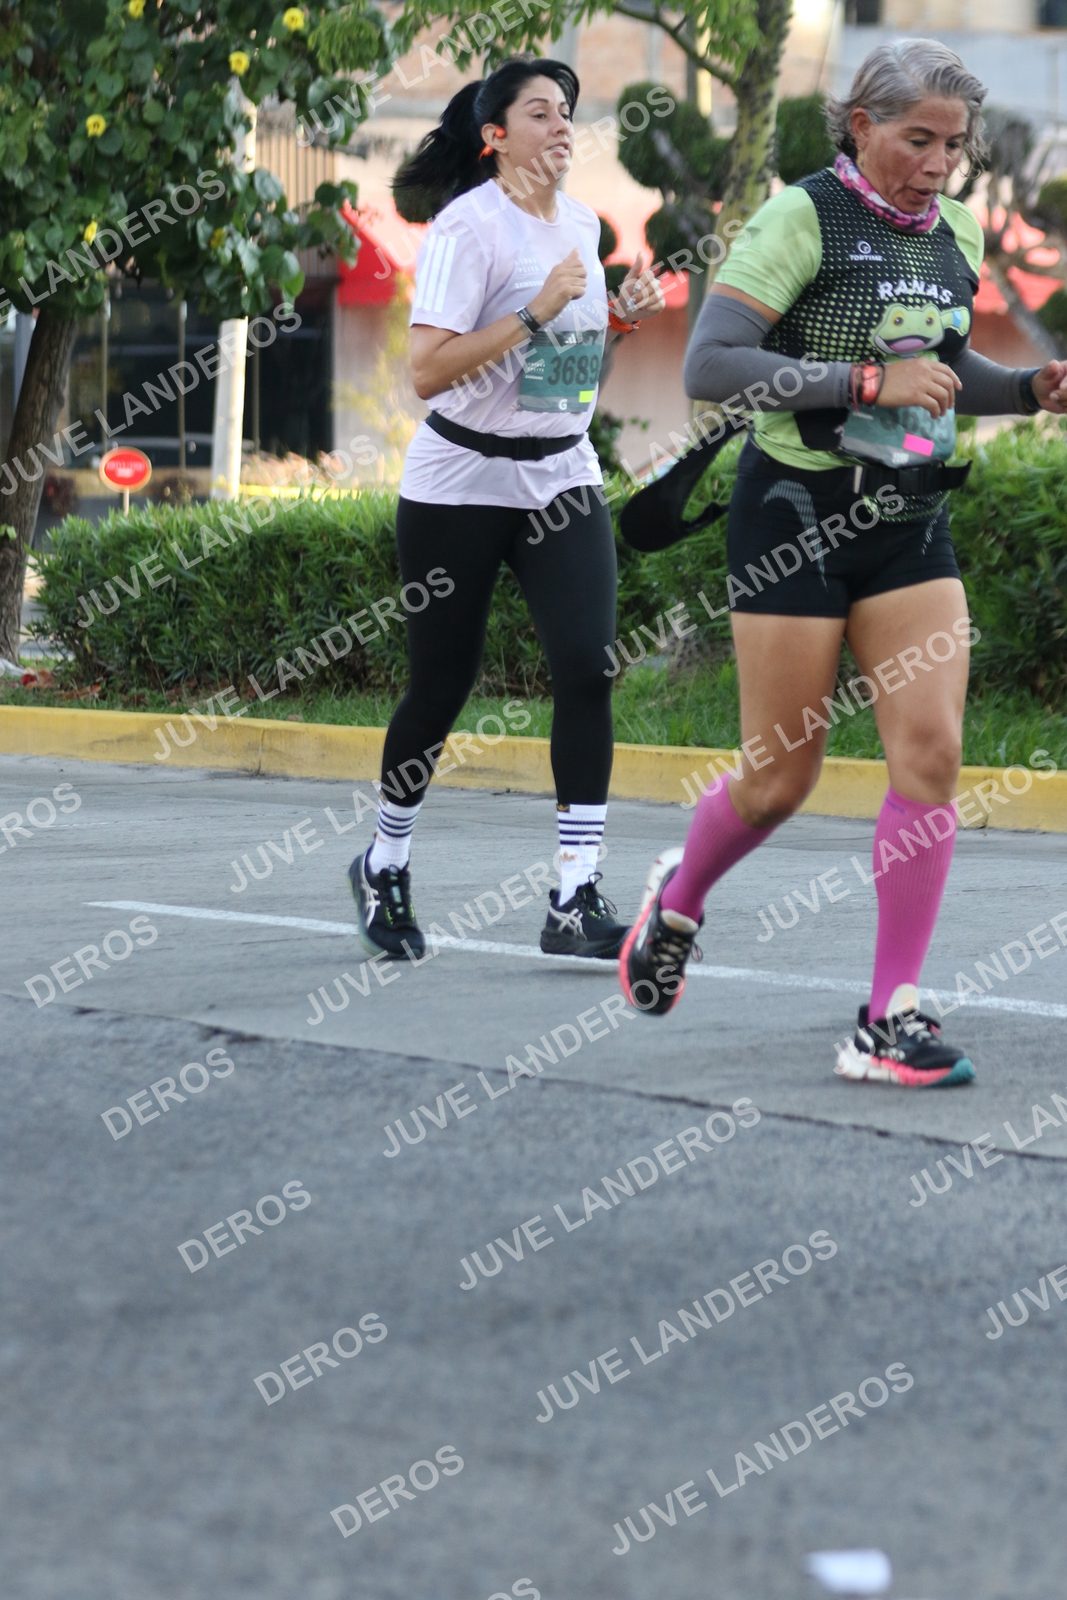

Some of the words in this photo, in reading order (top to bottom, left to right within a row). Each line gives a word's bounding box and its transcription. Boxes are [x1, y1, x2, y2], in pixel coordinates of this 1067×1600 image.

[878, 279, 953, 304] RANAS
[547, 353, 599, 386] 3689
[558, 398, 568, 410] G
